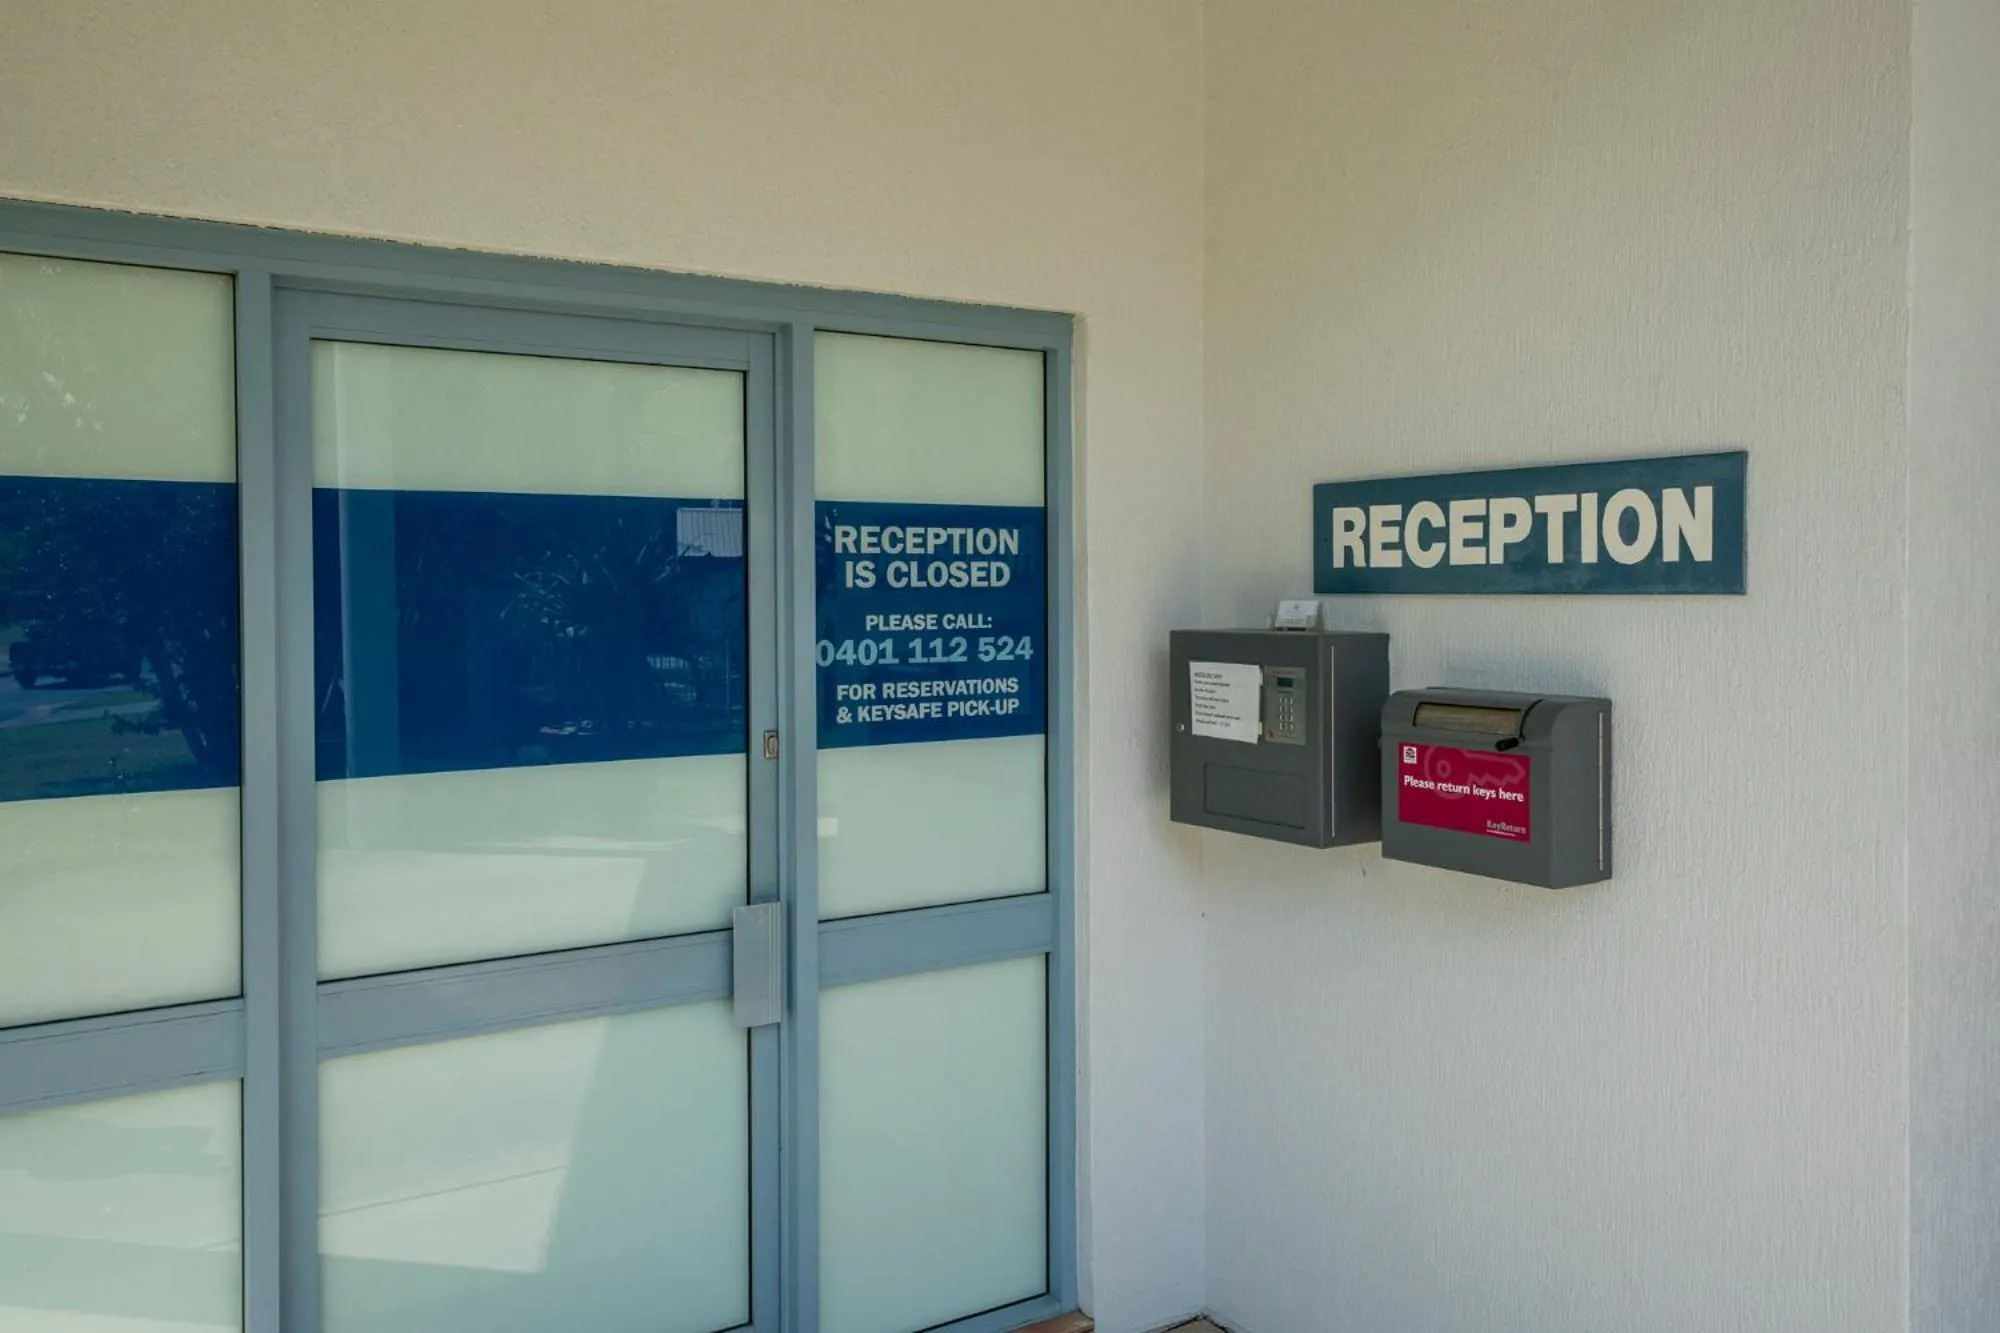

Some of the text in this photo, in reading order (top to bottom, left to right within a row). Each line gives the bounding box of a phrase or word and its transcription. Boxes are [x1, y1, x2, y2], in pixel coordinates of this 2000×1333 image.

[834, 525, 1019, 555] RECEPTION
[1332, 486, 1713, 568] RECEPTION
[845, 561, 1011, 588] IS CLOSED
[866, 614, 992, 631] PLEASE CALL:
[816, 636, 1033, 667] 0401 112 524
[837, 678, 1019, 701] FOR RESERVATIONS
[836, 698, 1019, 724] & KEYSAFE PICK-UP
[1403, 775, 1524, 803] Please return keys here
